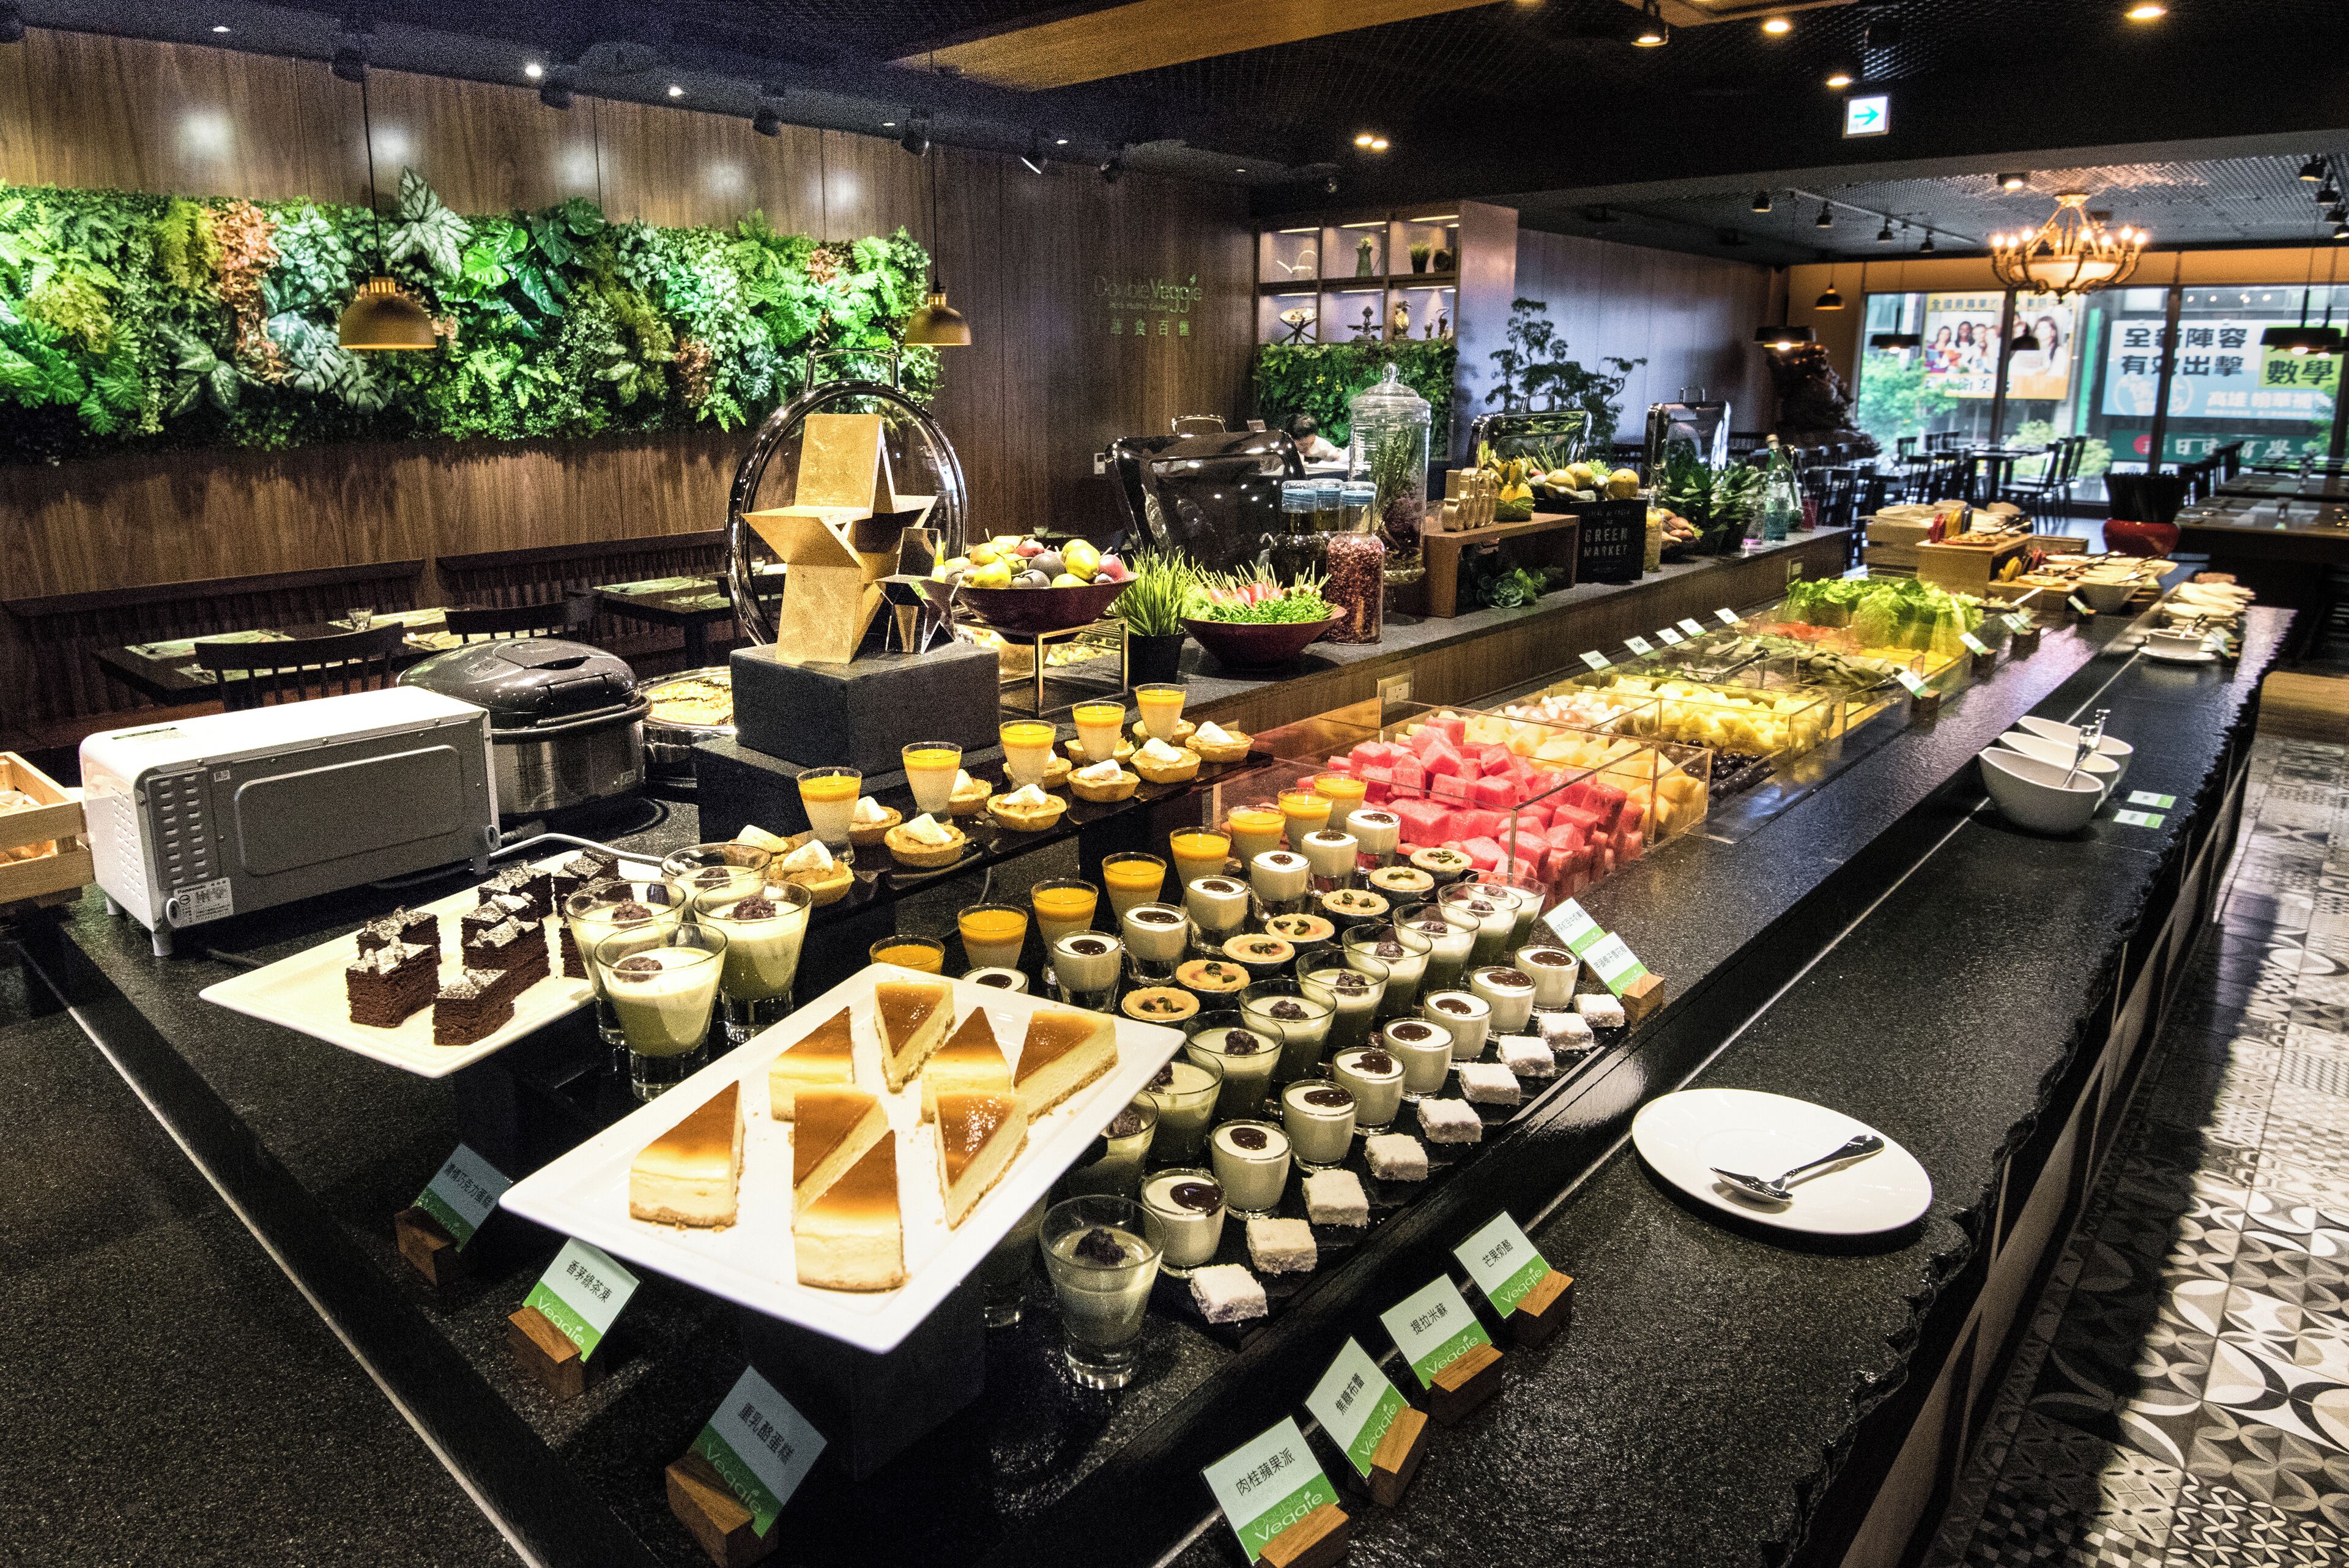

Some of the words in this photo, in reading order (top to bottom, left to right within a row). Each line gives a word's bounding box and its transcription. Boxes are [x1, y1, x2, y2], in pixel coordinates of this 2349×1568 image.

[2266, 359, 2334, 385] 數學
[1584, 544, 1628, 557] MARKET
[1585, 528, 1628, 543] GREEN
[1482, 1238, 1514, 1268] 芒果奶酪
[566, 1259, 613, 1304] 香茅綠茶凍
[1501, 1268, 1543, 1303] Veggie
[537, 1295, 585, 1345] Veggie
[1409, 1302, 1449, 1336] 提拉米蘇
[1425, 1335, 1479, 1375] Veggie
[1334, 1372, 1365, 1416] 焦糖布蕾
[737, 1402, 795, 1466] 重乳酪蛋糕
[1359, 1403, 1398, 1456] Veggie
[707, 1443, 762, 1515] Veggie
[1235, 1447, 1296, 1496] 肉桂蘋果派
[1254, 1491, 1323, 1541] Veggie
